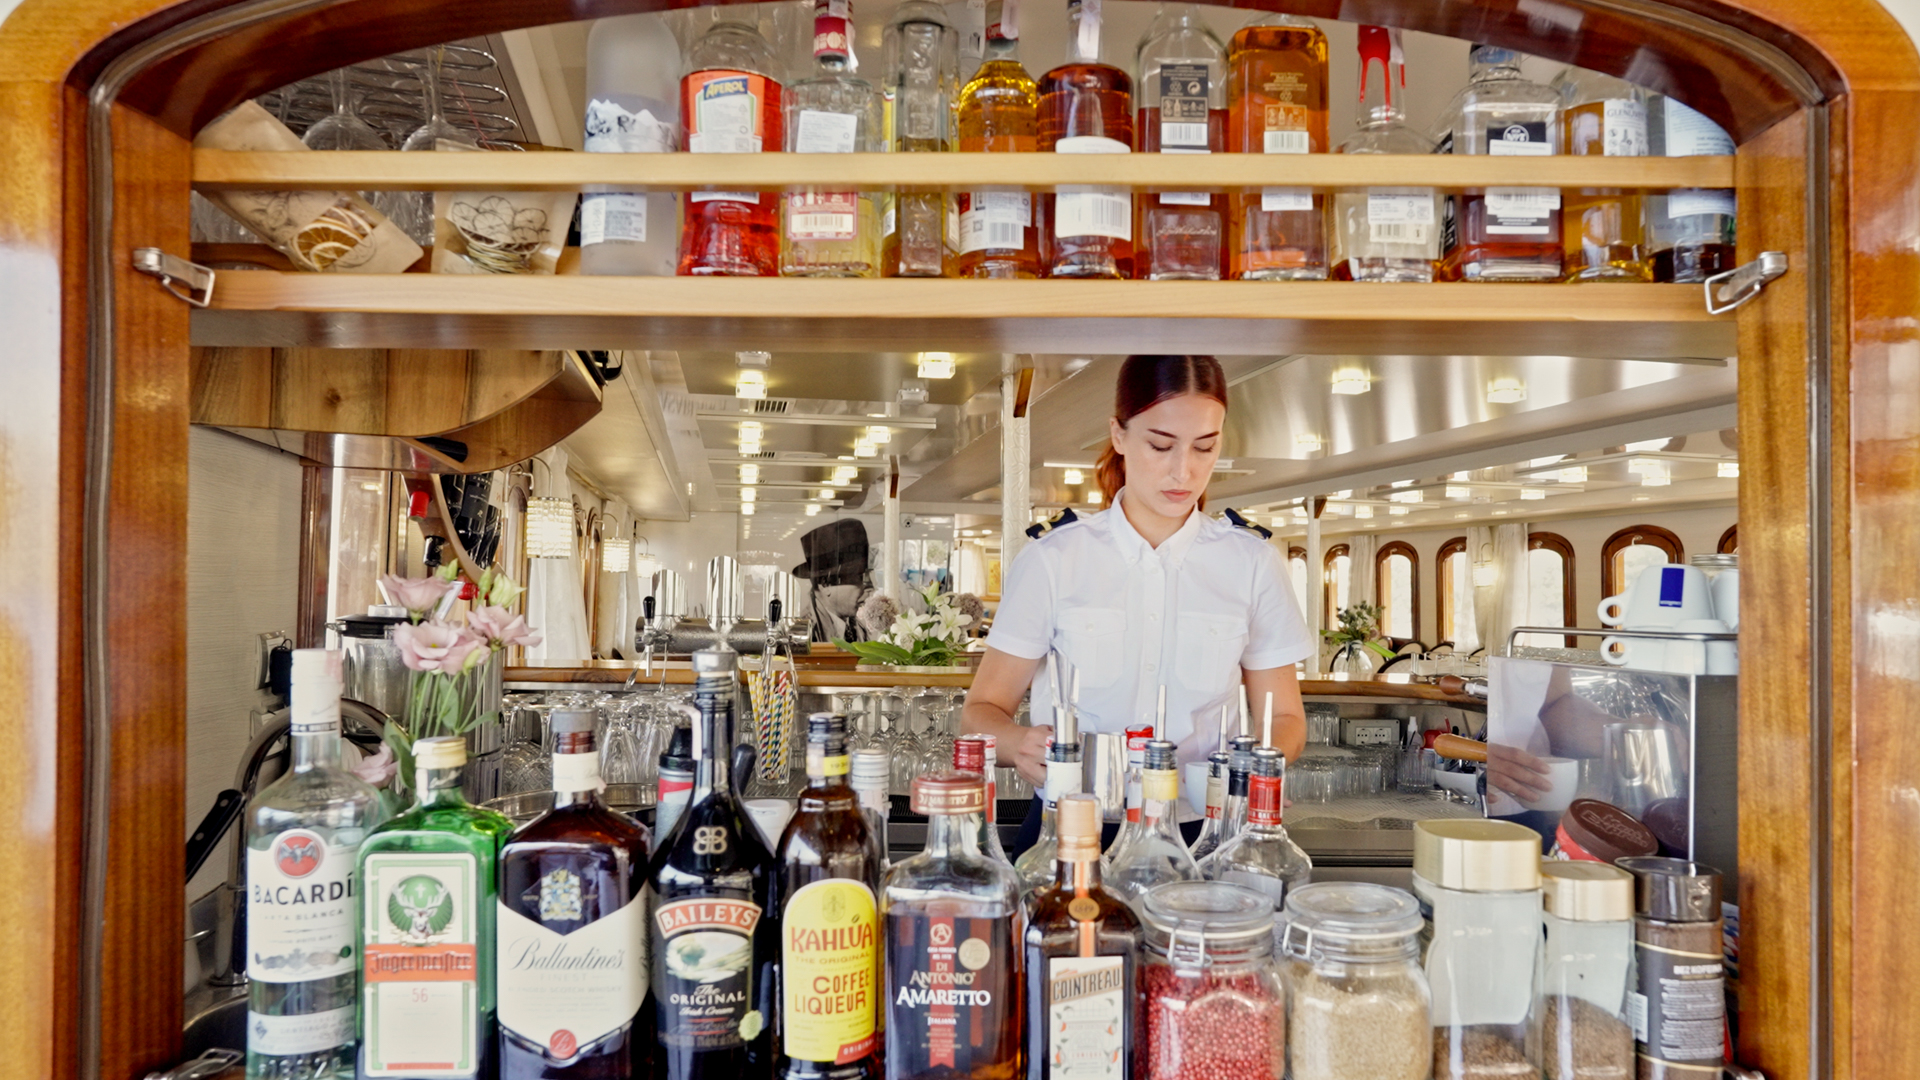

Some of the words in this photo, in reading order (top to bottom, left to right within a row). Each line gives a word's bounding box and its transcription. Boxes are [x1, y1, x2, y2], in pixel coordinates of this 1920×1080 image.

[706, 81, 745, 98] APEROL
[254, 872, 353, 905] BACARDÍ
[660, 904, 755, 930] BAILEYS
[791, 914, 873, 953] KAHLÚA
[508, 936, 625, 971] Ballantine's
[795, 956, 816, 964] THE
[819, 951, 871, 965] ORIGINAL
[936, 962, 948, 971] DI
[540, 973, 588, 982] FINEST
[813, 967, 870, 994] COFFEE
[909, 970, 975, 989] ANTONIO
[1053, 967, 1120, 1001] COINTREAU
[412, 987, 428, 1003] 56
[550, 986, 585, 994] SCOTCH
[669, 990, 746, 1006] ORIGINAL
[694, 984, 721, 996] The
[896, 985, 991, 1008] AMARETTO
[794, 990, 866, 1015] LIQUEUR
[927, 1016, 957, 1026] ITALIANA
